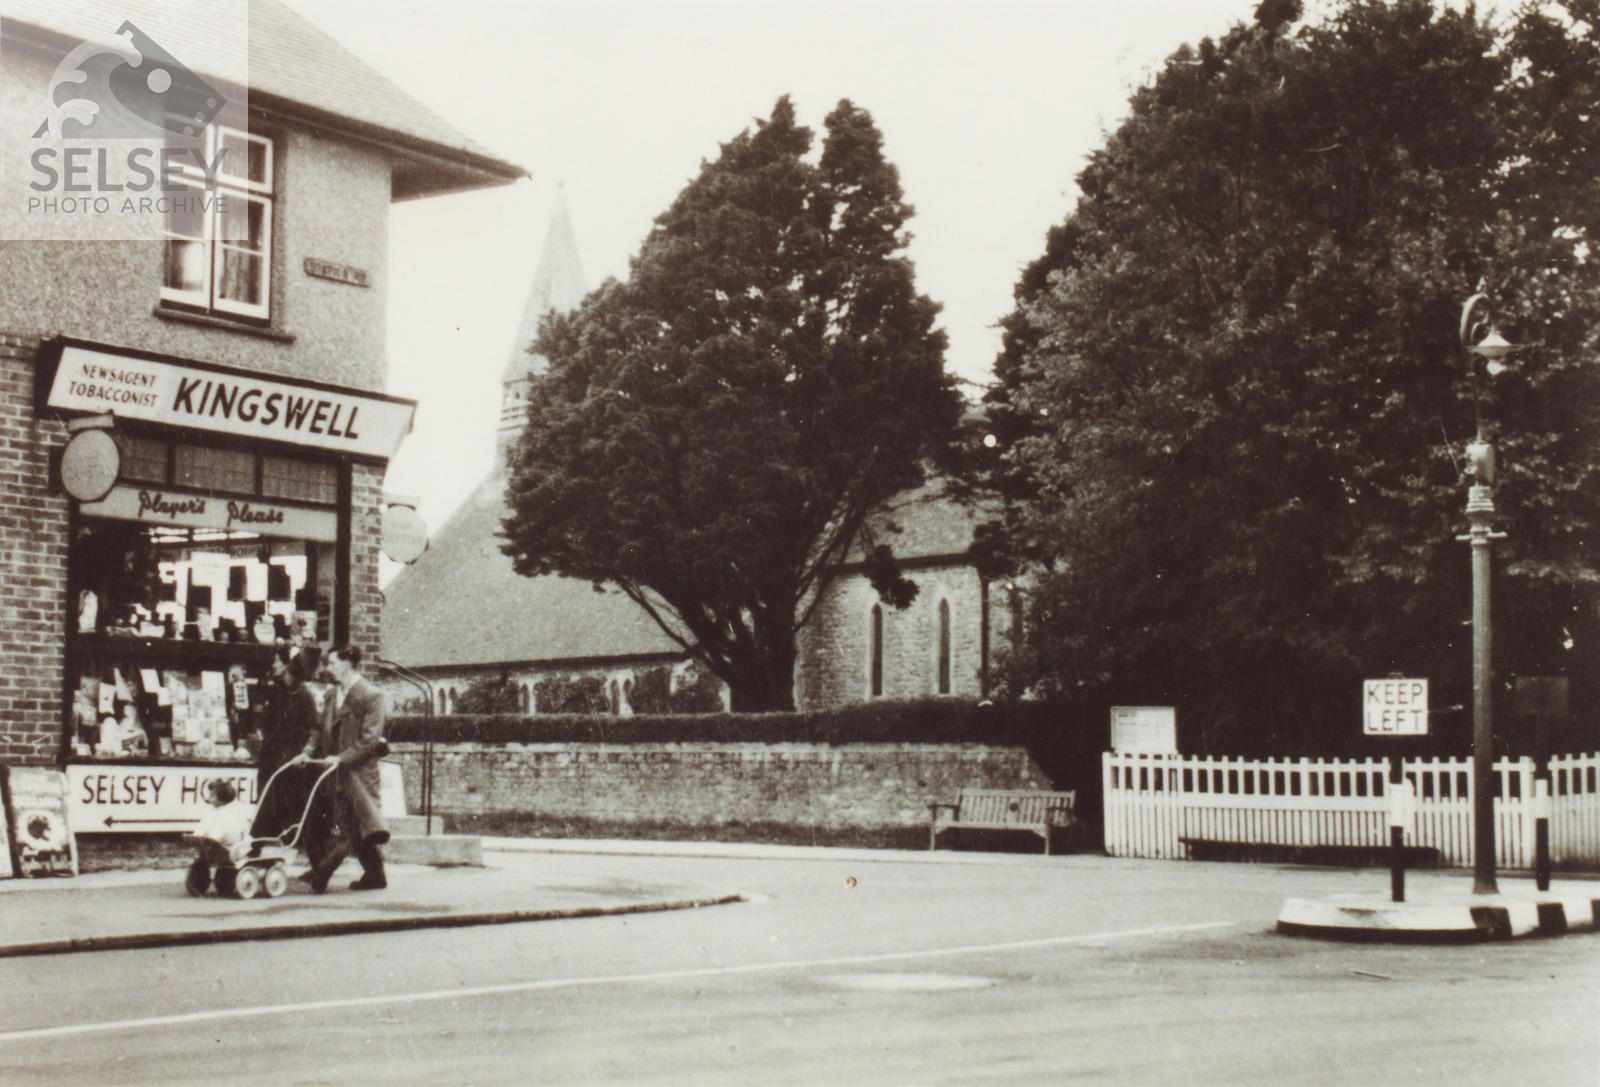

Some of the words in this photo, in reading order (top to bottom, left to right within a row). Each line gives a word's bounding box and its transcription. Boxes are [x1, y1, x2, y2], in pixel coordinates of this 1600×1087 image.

[82, 364, 157, 388] NEWSAGENT
[69, 381, 158, 408] TOBACCONIST
[172, 376, 359, 439] KINGSWELL
[138, 490, 205, 519] Player's
[227, 501, 284, 527] Please
[1367, 683, 1423, 704] KEEP
[1367, 710, 1423, 731] LEFT
[82, 775, 165, 804] SELSEY
[181, 776, 258, 804] HOEL
